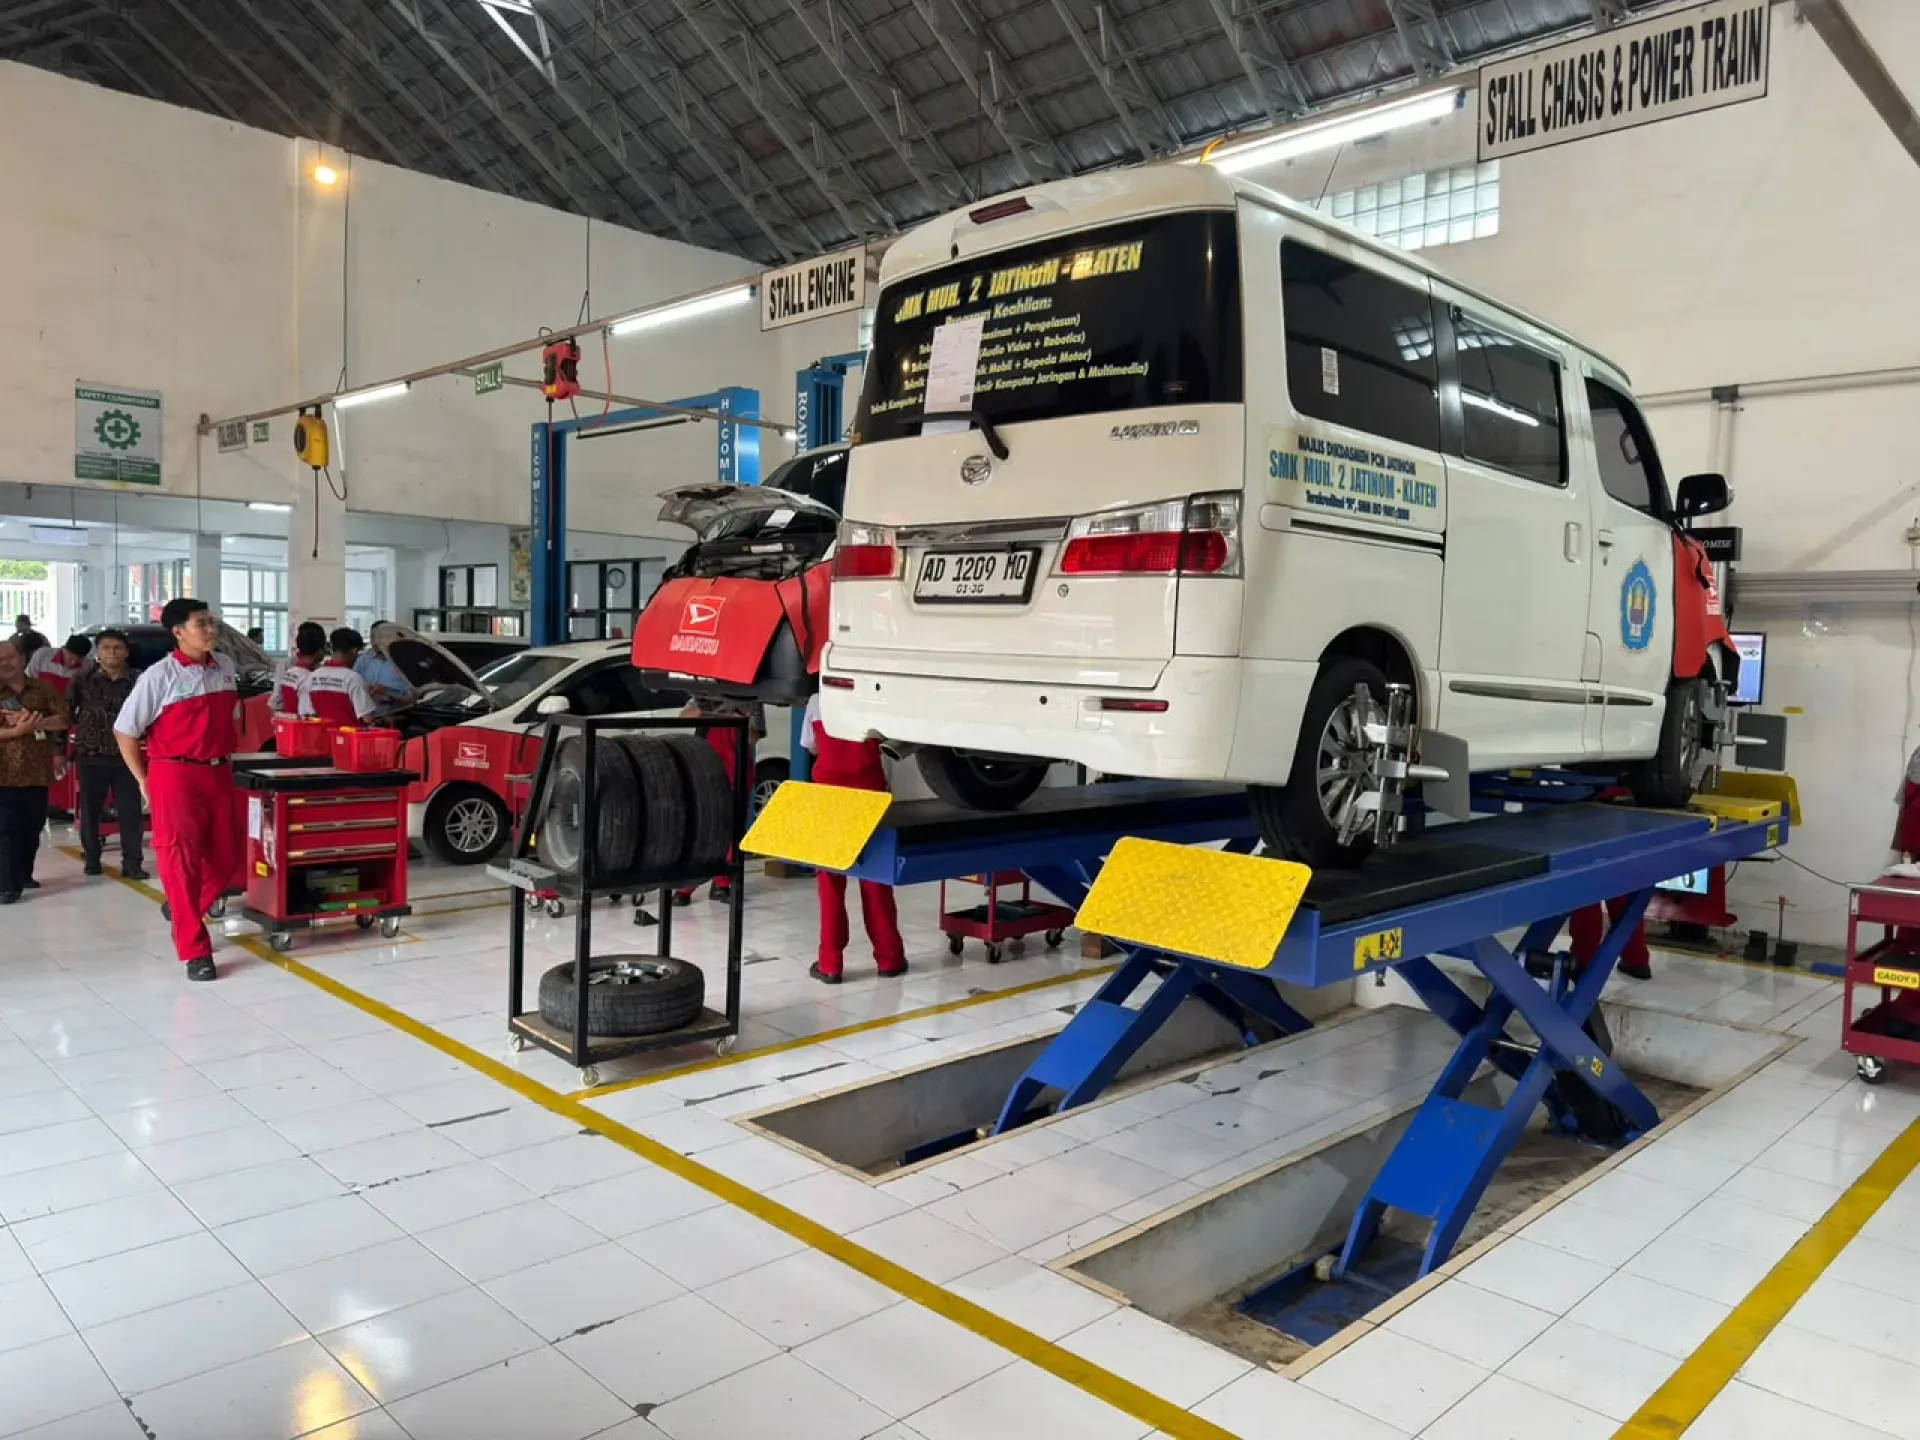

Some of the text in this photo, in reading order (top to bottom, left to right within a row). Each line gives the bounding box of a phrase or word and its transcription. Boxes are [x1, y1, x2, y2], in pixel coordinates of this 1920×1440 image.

[1486, 6, 1763, 145] STALL CHASIS & POWER TRAIN
[769, 257, 856, 321] STALL ENGINE
[926, 281, 960, 313] MUH.
[968, 275, 983, 303] 2
[993, 297, 1053, 319] Keahlian:
[1088, 360, 1150, 378] Multimedia)
[1269, 450, 1298, 481] SMK
[1304, 456, 1333, 488] MUH.
[1338, 464, 1346, 490] 2
[1350, 467, 1395, 499] JATINOM
[1403, 478, 1437, 508] KLATEN
[922, 558, 946, 582] AD
[952, 556, 996, 582] 1209
